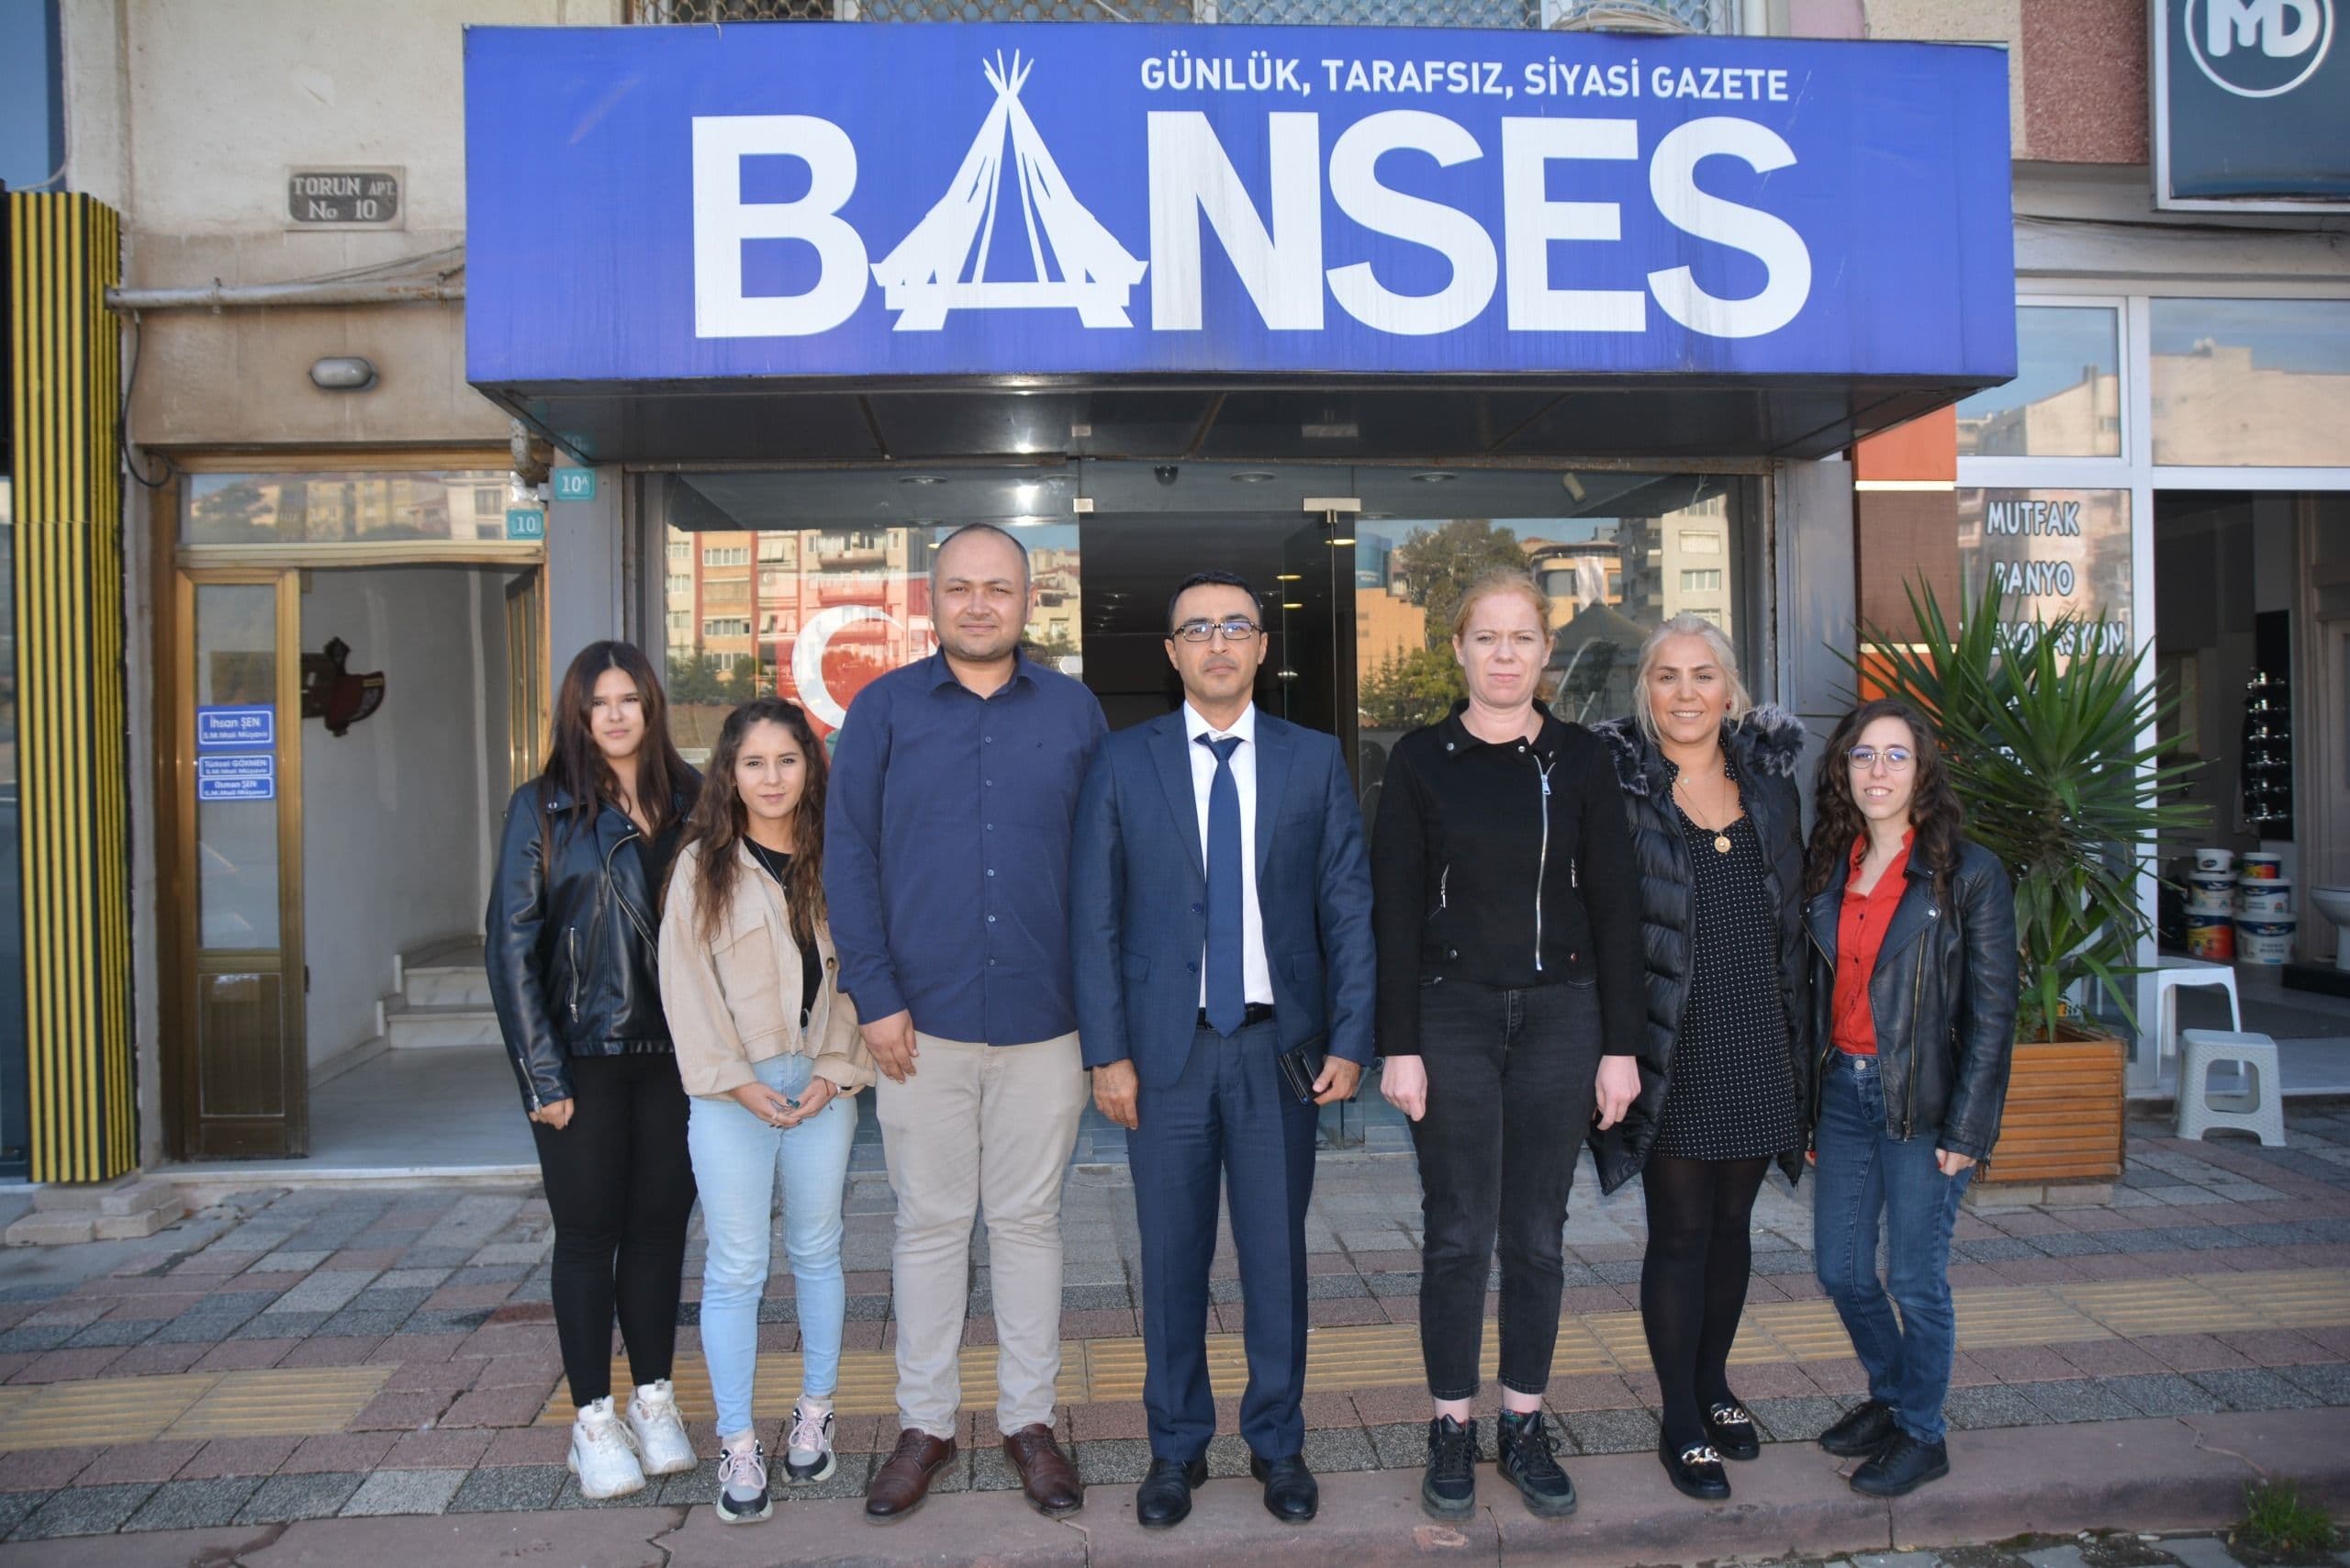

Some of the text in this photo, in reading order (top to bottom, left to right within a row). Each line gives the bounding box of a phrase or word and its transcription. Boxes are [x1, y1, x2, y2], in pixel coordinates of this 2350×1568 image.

[2207, 0, 2320, 57] MD
[1140, 55, 1789, 101] GÜNLÜK, TARAFSIZ, SİYASİ GAZETE
[294, 176, 361, 196] TORUN
[691, 49, 1813, 339] BANSES
[308, 199, 377, 219] No 10
[517, 516, 536, 532] 10
[1986, 501, 2080, 536] MUTFAK
